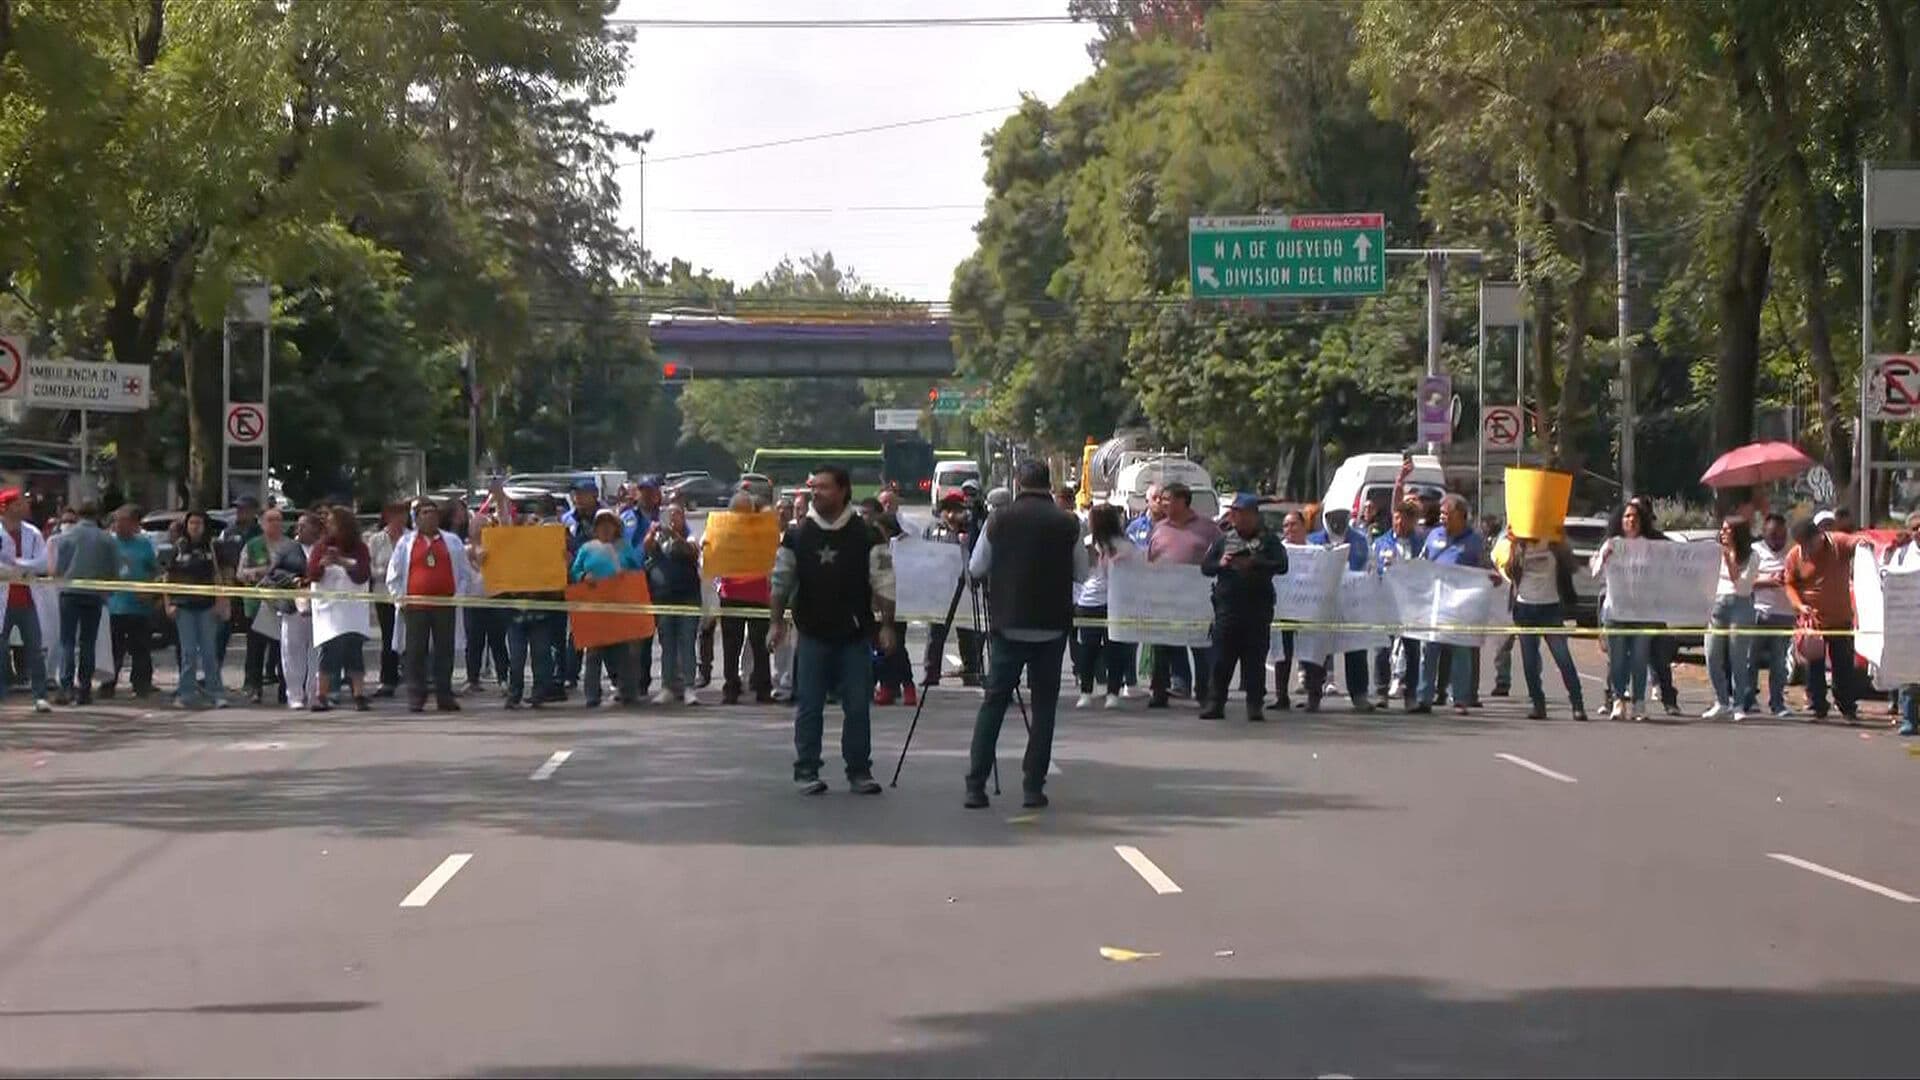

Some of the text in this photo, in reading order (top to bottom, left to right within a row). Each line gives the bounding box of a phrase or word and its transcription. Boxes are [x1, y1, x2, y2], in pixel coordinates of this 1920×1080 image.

[1214, 238, 1344, 259] M A DE QUEVEDO
[1224, 265, 1378, 287] DIVISION DEL NORTE
[101, 368, 118, 382] EN
